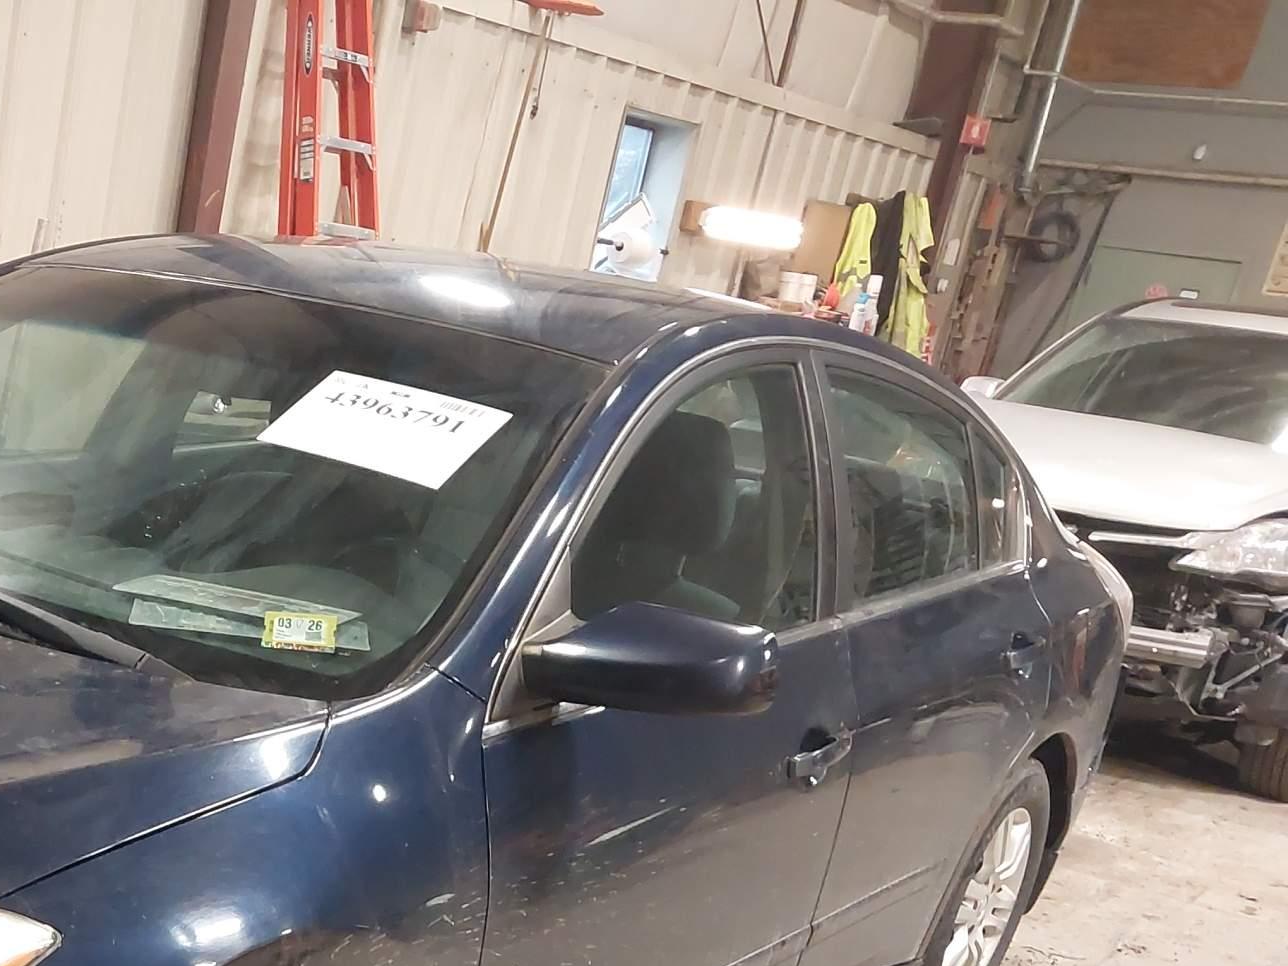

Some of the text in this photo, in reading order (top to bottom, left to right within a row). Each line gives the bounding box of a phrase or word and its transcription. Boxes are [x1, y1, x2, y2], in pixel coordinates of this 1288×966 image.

[324, 391, 465, 434] 43963791
[277, 617, 323, 631] 03 26
